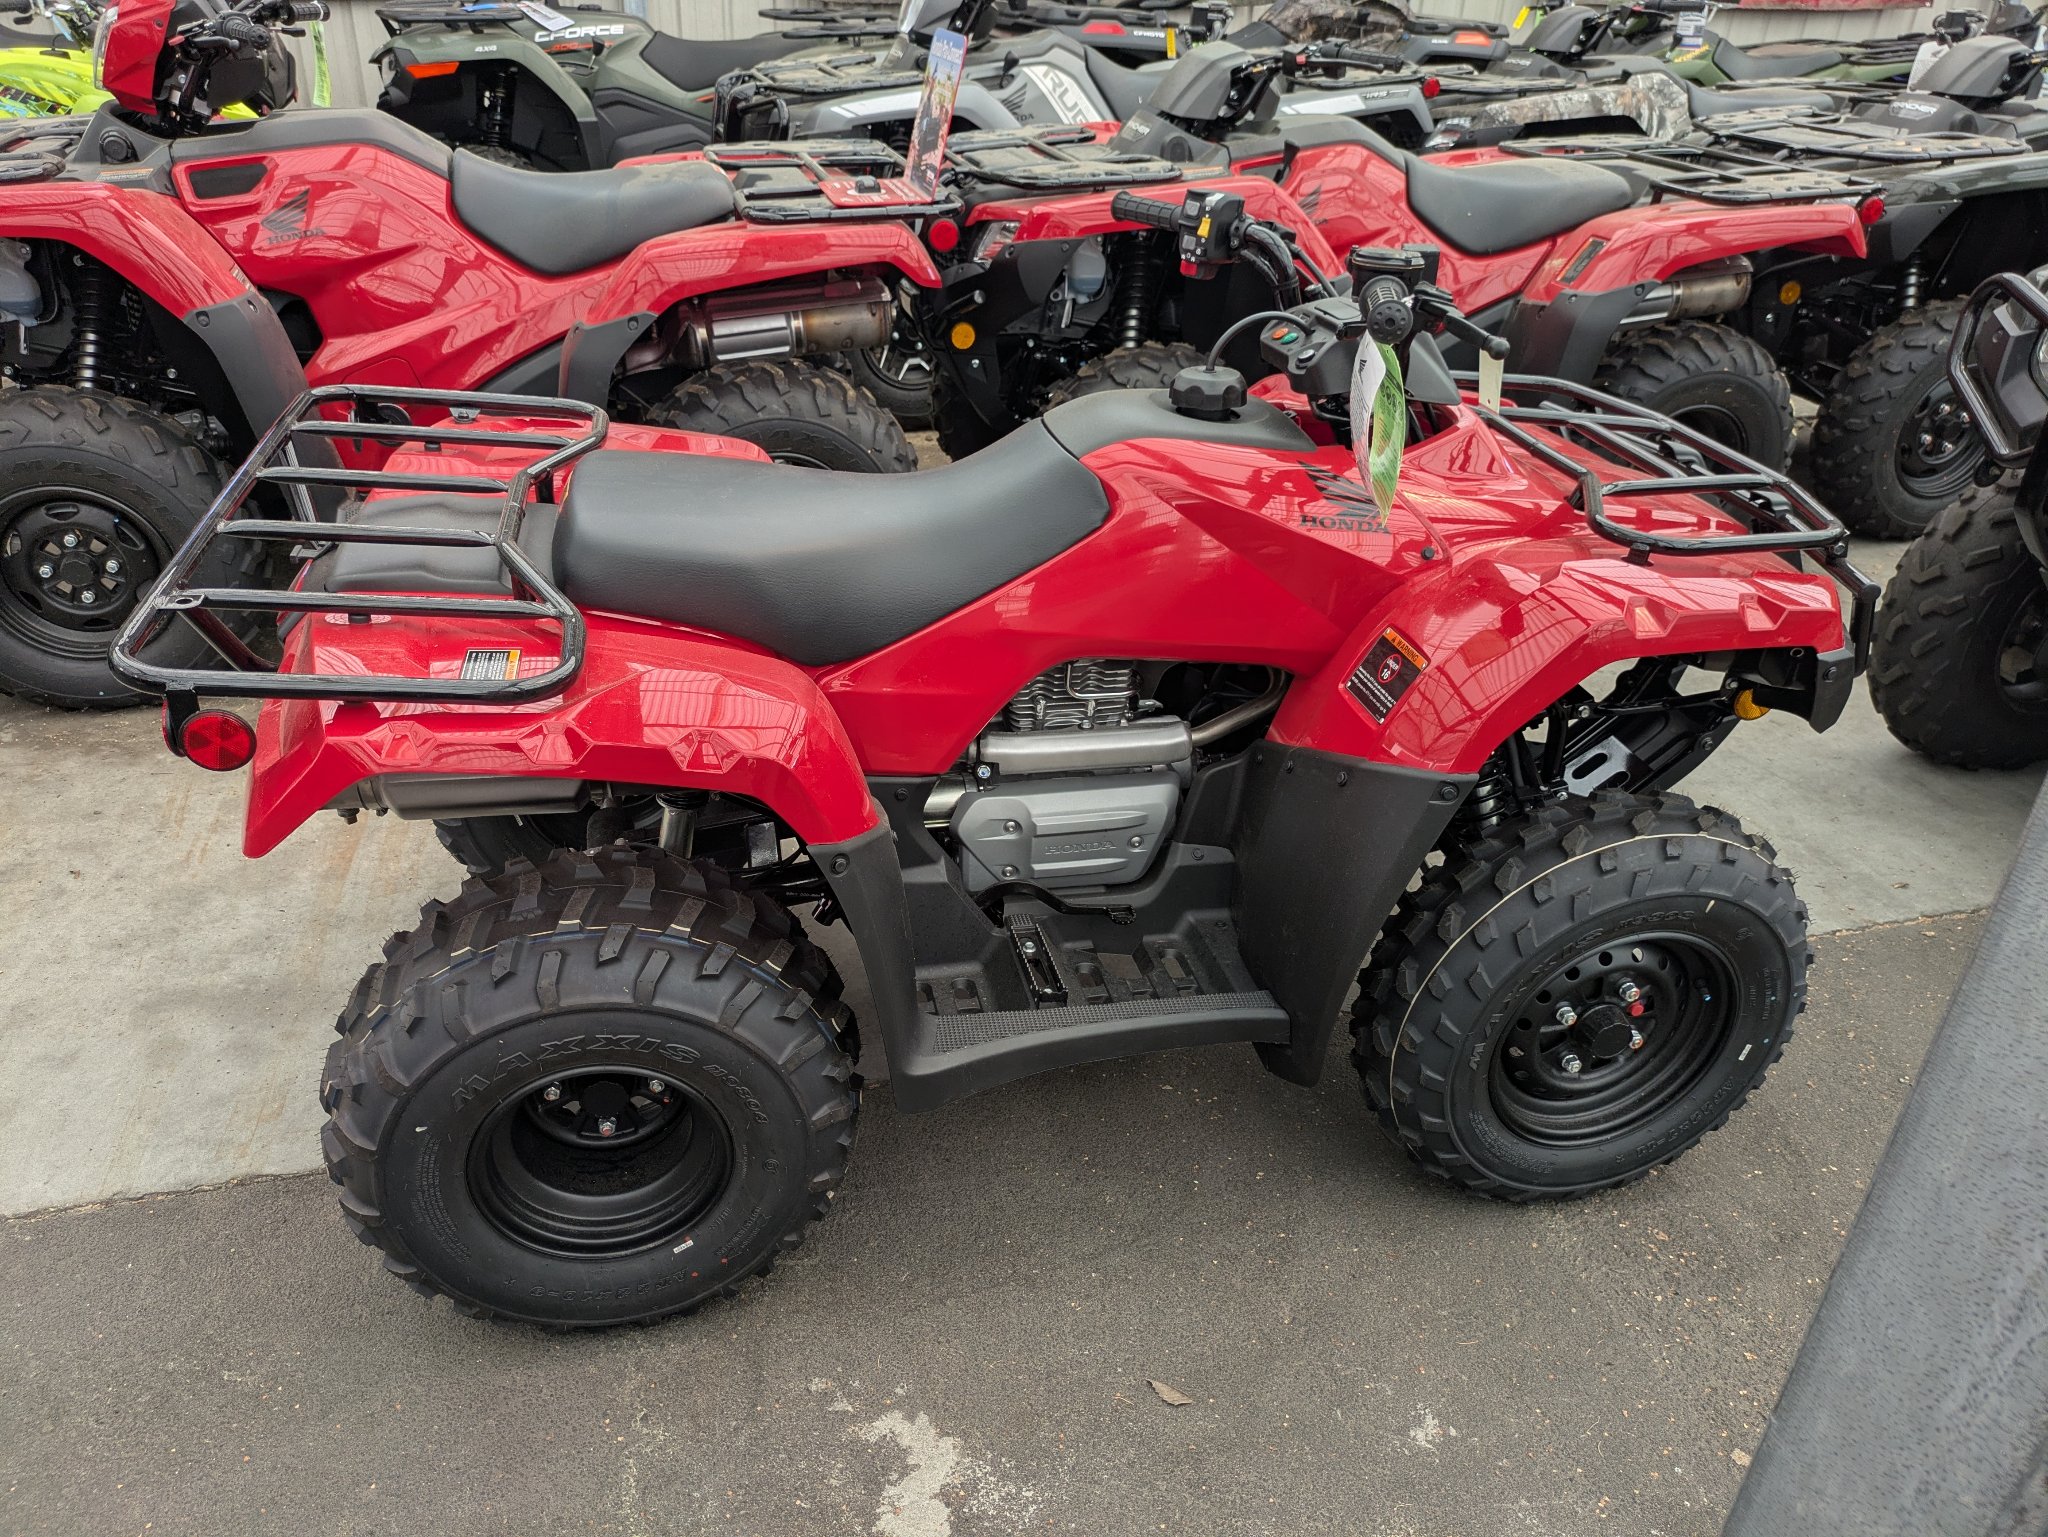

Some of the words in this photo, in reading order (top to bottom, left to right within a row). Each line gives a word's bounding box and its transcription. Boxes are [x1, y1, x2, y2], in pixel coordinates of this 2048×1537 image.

[534, 24, 624, 42] CFORCE
[268, 227, 326, 245] HONDA
[1300, 515, 1392, 534] HONDA
[1396, 637, 1420, 663] WARNING
[1386, 657, 1400, 671] UNDER
[1381, 668, 1391, 680] 16
[1045, 841, 1118, 855] HONDA
[451, 1034, 701, 1113] MAXXIS
